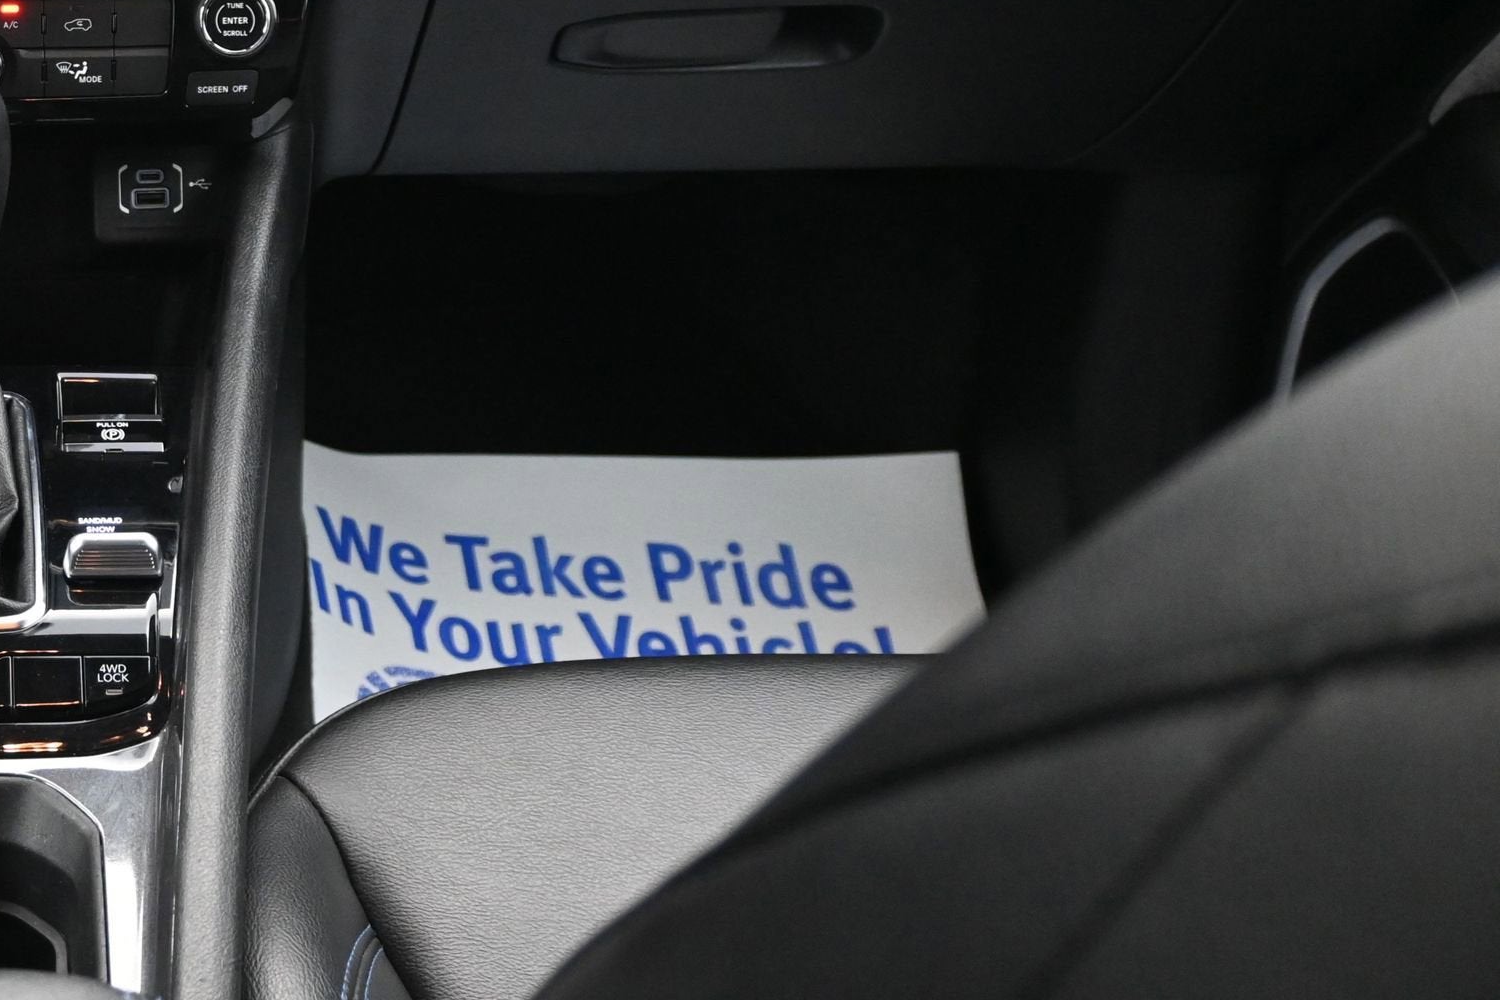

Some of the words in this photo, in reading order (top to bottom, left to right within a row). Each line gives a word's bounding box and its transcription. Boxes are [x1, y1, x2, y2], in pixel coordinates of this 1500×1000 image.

[3, 20, 19, 29] A/C
[221, 16, 249, 25] ENTER
[222, 29, 248, 37] SCROLL
[78, 75, 103, 84] MODE
[197, 85, 229, 94] SCREEN
[232, 85, 248, 93] OFF
[85, 525, 116, 533] SNOW
[316, 505, 429, 586] We
[443, 533, 626, 601] Take
[646, 541, 857, 612] Pride
[309, 557, 375, 636] In
[388, 589, 563, 665] Your
[577, 610, 895, 659] Vehil
[99, 664, 127, 674] 4WD
[96, 673, 129, 684] LOCK
